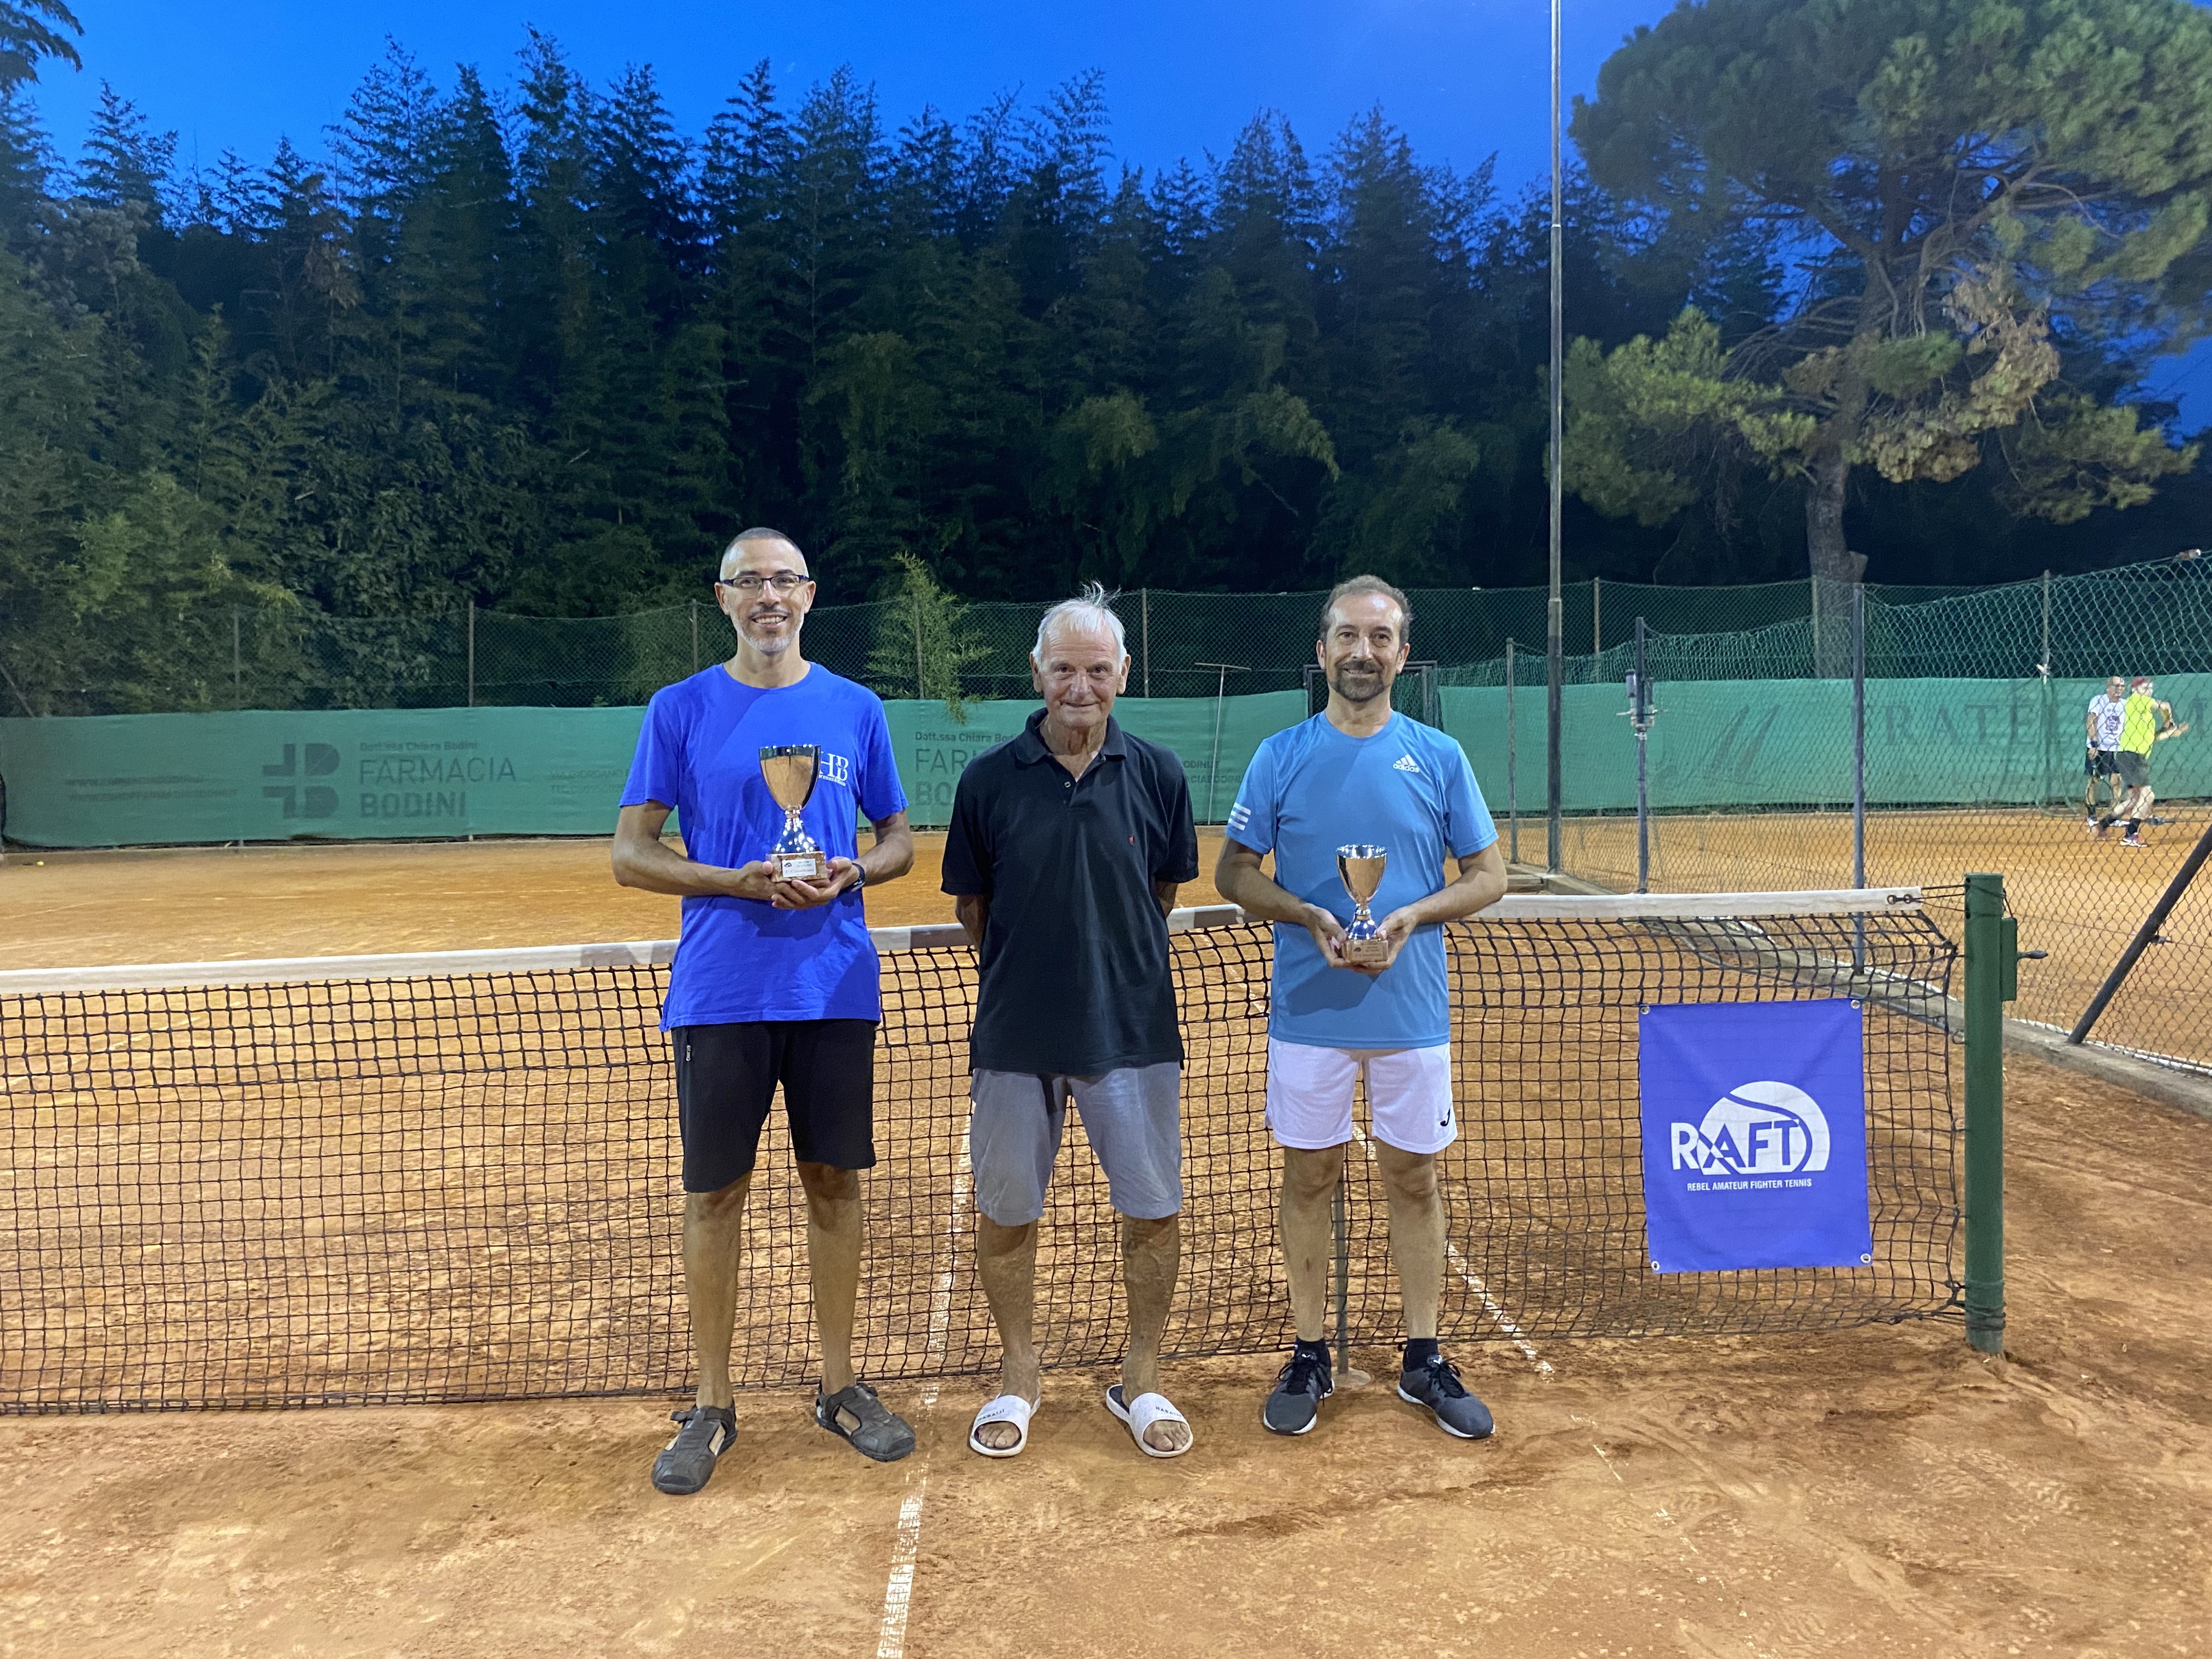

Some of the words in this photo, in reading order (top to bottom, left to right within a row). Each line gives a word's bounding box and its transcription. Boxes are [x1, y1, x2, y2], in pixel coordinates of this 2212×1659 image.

[916, 732, 956, 741] Dott.ssa
[959, 733, 991, 742] Chiara
[360, 757, 516, 785] FARMACIA
[916, 748, 978, 774] FAR
[1393, 763, 1420, 773] adidas
[360, 791, 466, 818] BODINI
[1671, 1118, 1800, 1170] RAFT
[1687, 1181, 1711, 1191] REBEL
[1712, 1181, 1748, 1190] AMATEUR
[1750, 1180, 1783, 1189] FIGHTER
[1784, 1178, 1812, 1188] TENNIS
